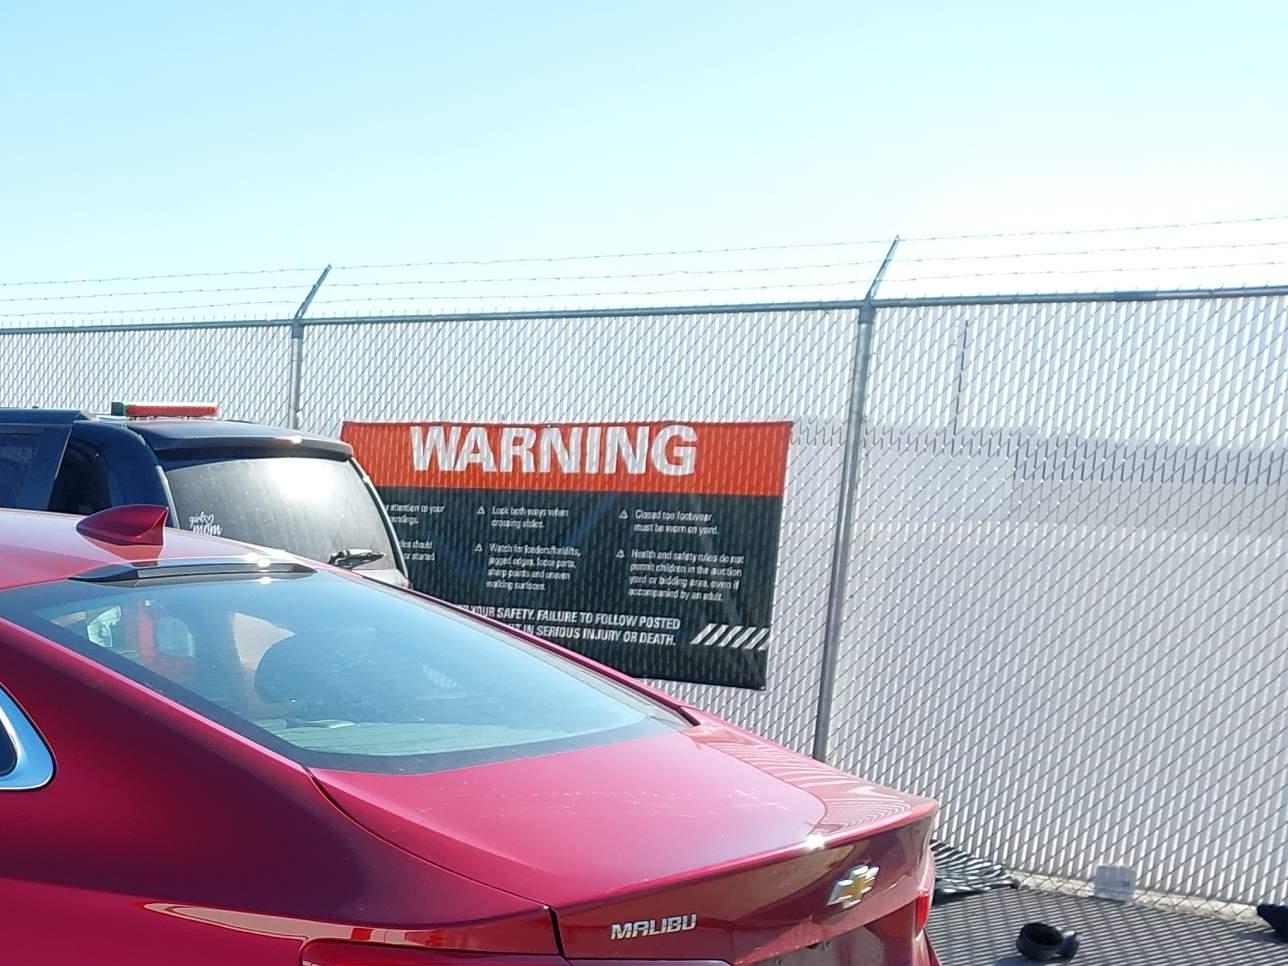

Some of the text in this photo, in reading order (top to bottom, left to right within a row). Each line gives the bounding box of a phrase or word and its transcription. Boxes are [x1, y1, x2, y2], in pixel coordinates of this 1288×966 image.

[410, 425, 698, 476] WARNING
[492, 506, 569, 518] Look both ways when
[635, 509, 713, 522] Closed toe footwear
[192, 524, 222, 536] mom
[491, 519, 521, 529] crossing
[633, 523, 720, 536] must be worn on yard.
[489, 543, 513, 553] Watch
[514, 544, 523, 553] for
[488, 556, 512, 567] jagged
[631, 549, 745, 564] Health and safety rules do not
[487, 568, 507, 578] sharp
[531, 569, 545, 578] and
[545, 571, 571, 580] uneven
[630, 562, 743, 577] permit children in the auction
[486, 580, 514, 591] walking
[629, 575, 647, 585] yard
[648, 576, 658, 584] or
[659, 576, 689, 588] bidding
[711, 580, 732, 589] even
[733, 580, 741, 590] if
[628, 588, 679, 599] accompanied
[679, 590, 690, 601] by
[691, 591, 702, 600] an
[471, 605, 496, 617] YOUR
[536, 609, 578, 624] FAILURE
[579, 611, 593, 624] TO
[595, 612, 639, 627] FOLLOW
[639, 615, 681, 630] POSTED
[523, 623, 535, 635] IN
[535, 624, 581, 640] SERIOUS
[582, 627, 622, 641] INJURY
[623, 630, 638, 643] OR
[638, 632, 677, 646] DEATH.
[610, 913, 697, 940] MALIBU
